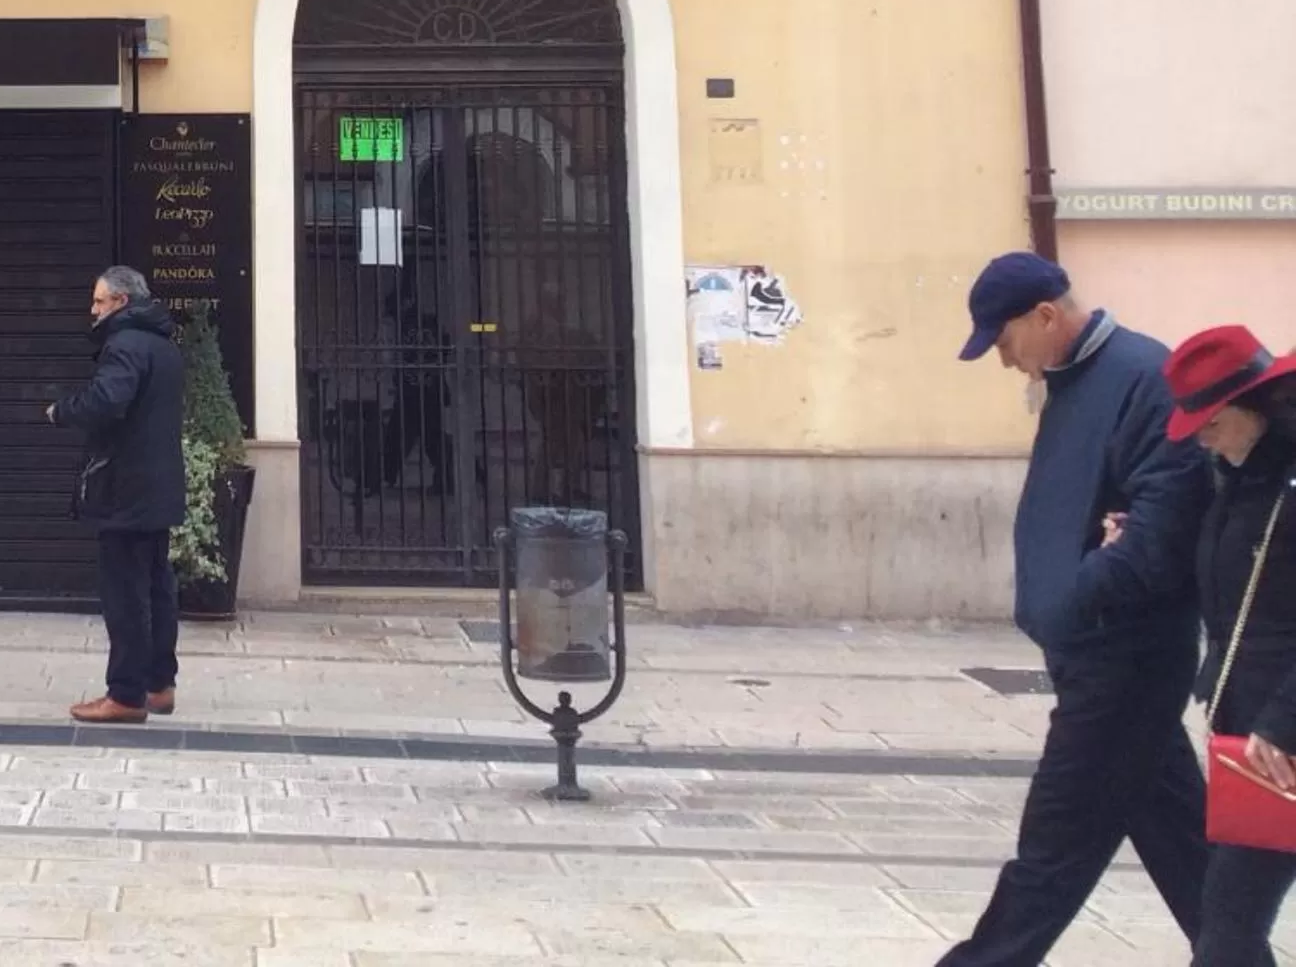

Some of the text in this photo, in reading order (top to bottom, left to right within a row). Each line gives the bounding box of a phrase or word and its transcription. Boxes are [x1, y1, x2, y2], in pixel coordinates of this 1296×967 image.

[1057, 194, 1160, 211] YOGURT
[1166, 194, 1252, 211] BUDINI
[153, 266, 215, 279] PANDORA
